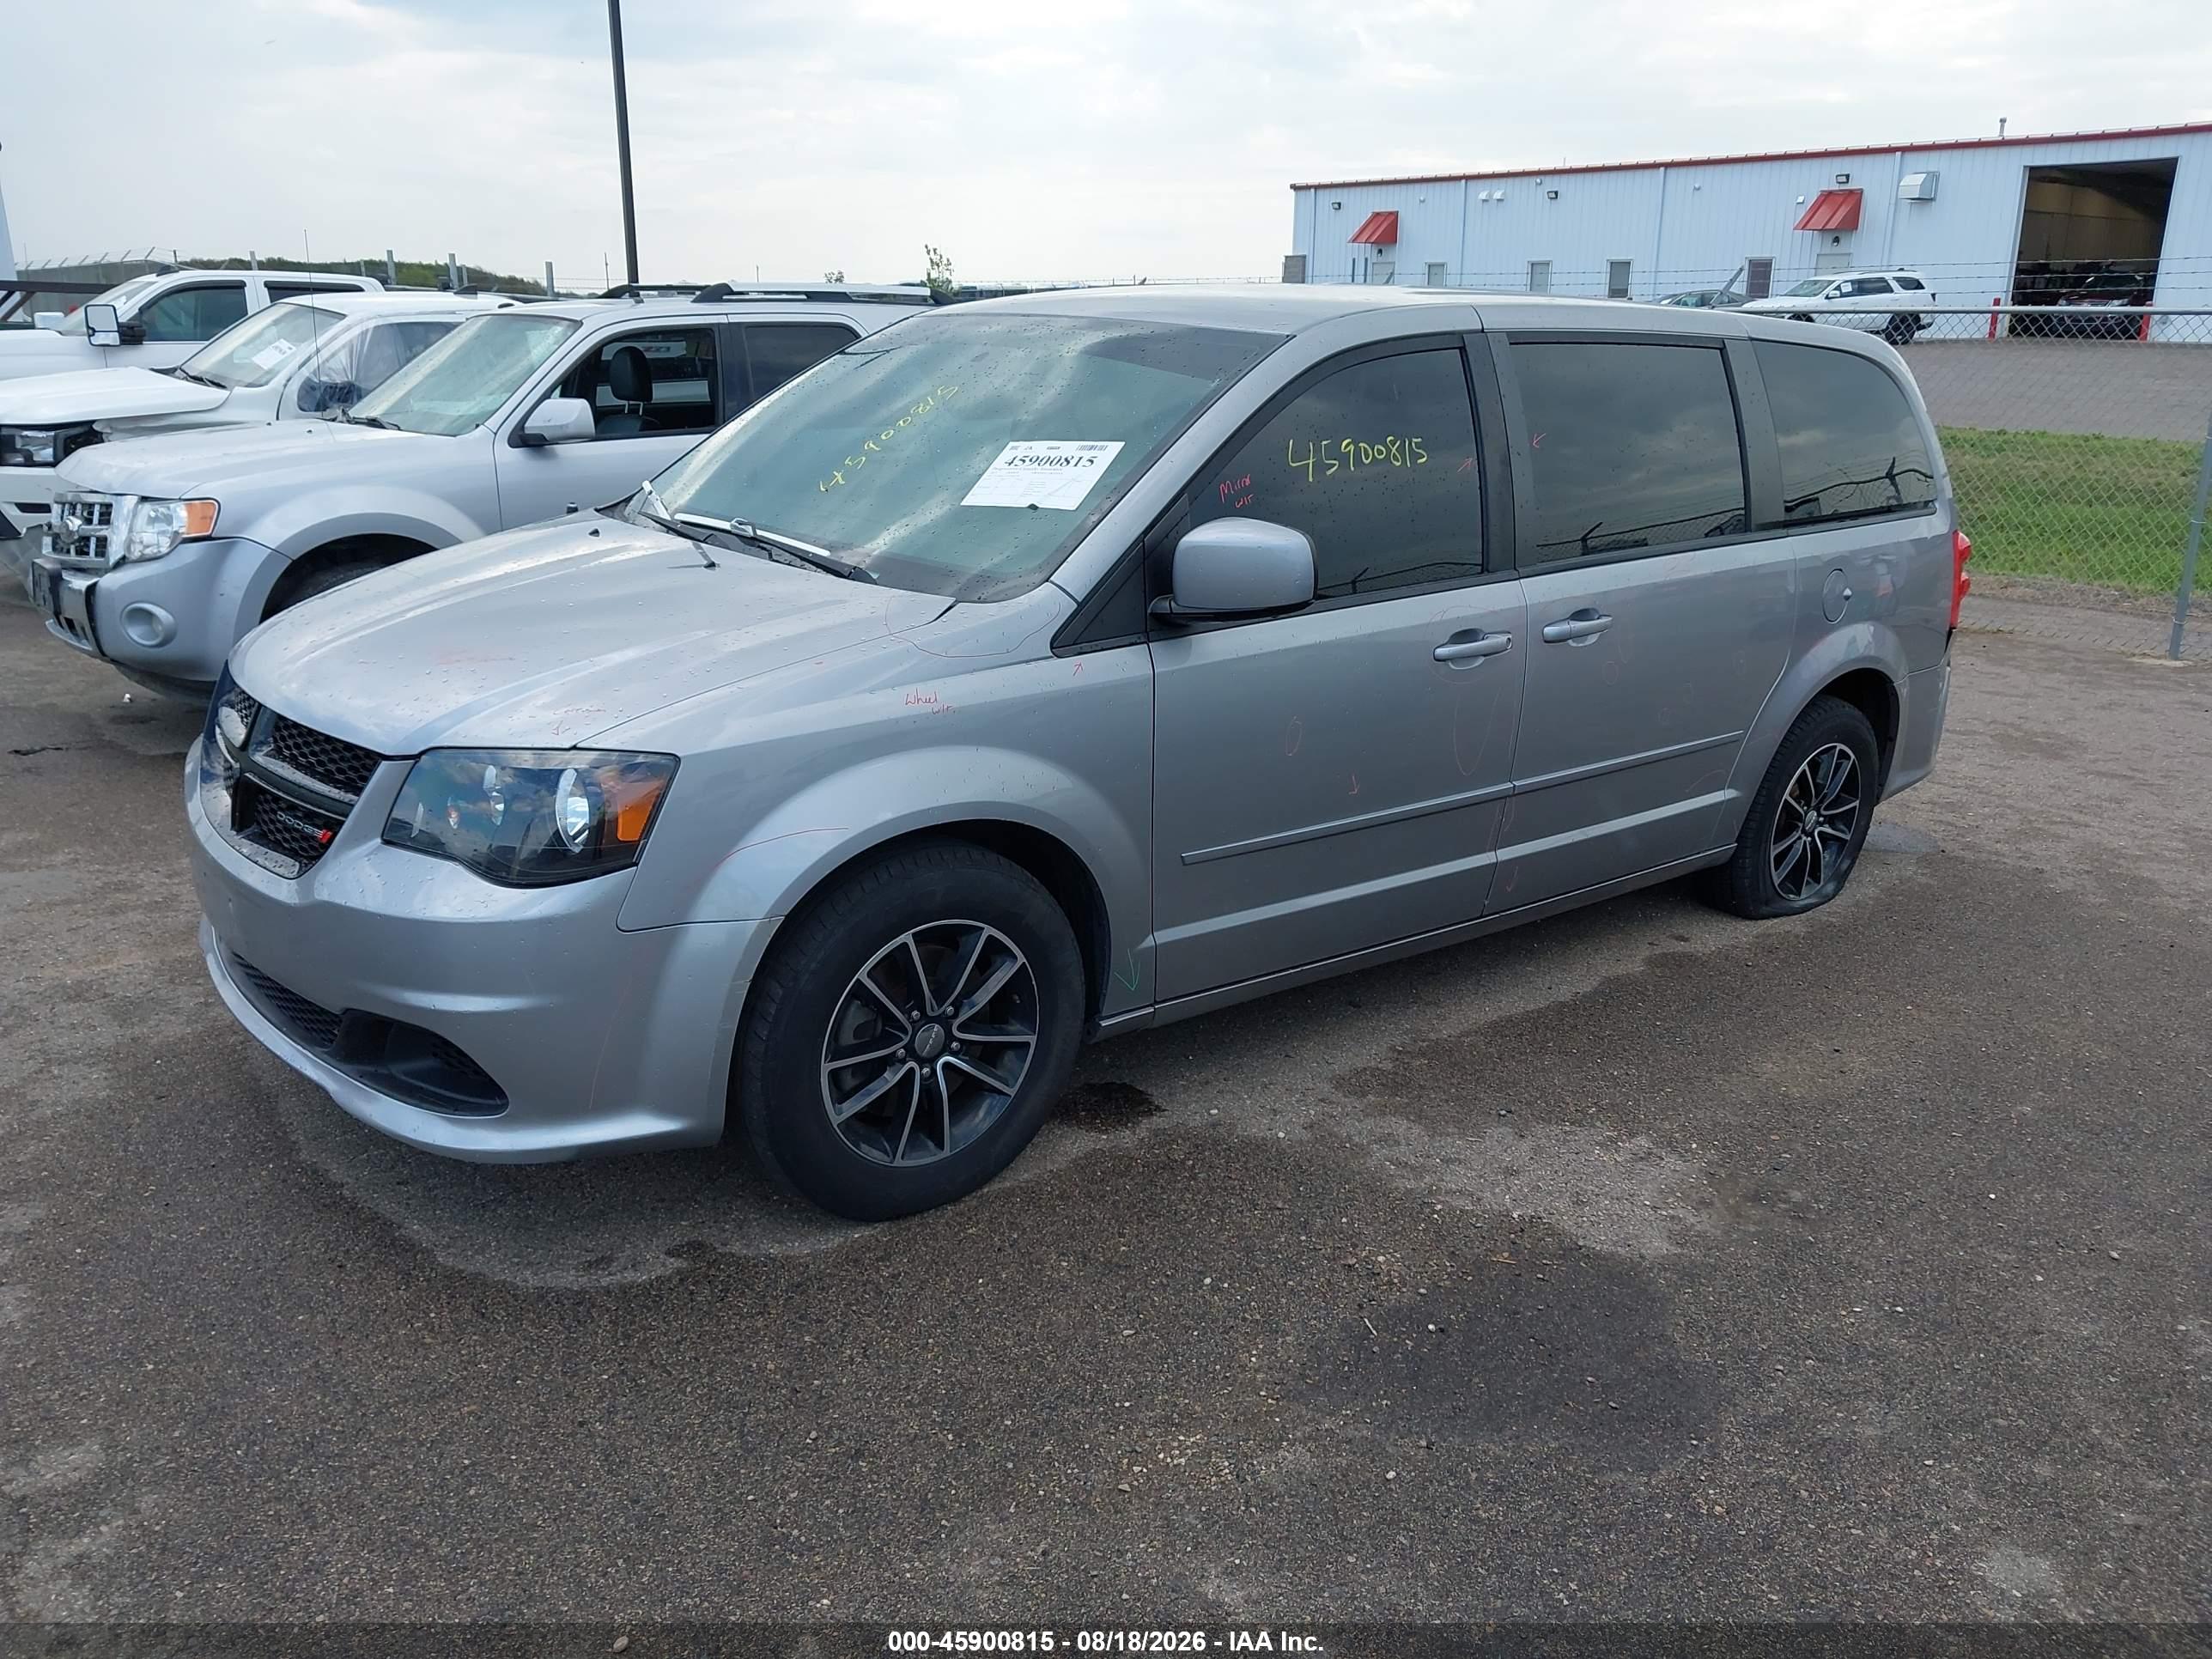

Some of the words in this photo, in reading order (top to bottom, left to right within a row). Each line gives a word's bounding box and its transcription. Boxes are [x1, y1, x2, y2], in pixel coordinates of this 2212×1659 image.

[1004, 455, 1098, 468] 45900815
[1288, 435, 1427, 482] 45900815
[276, 811, 324, 839] DODGE
